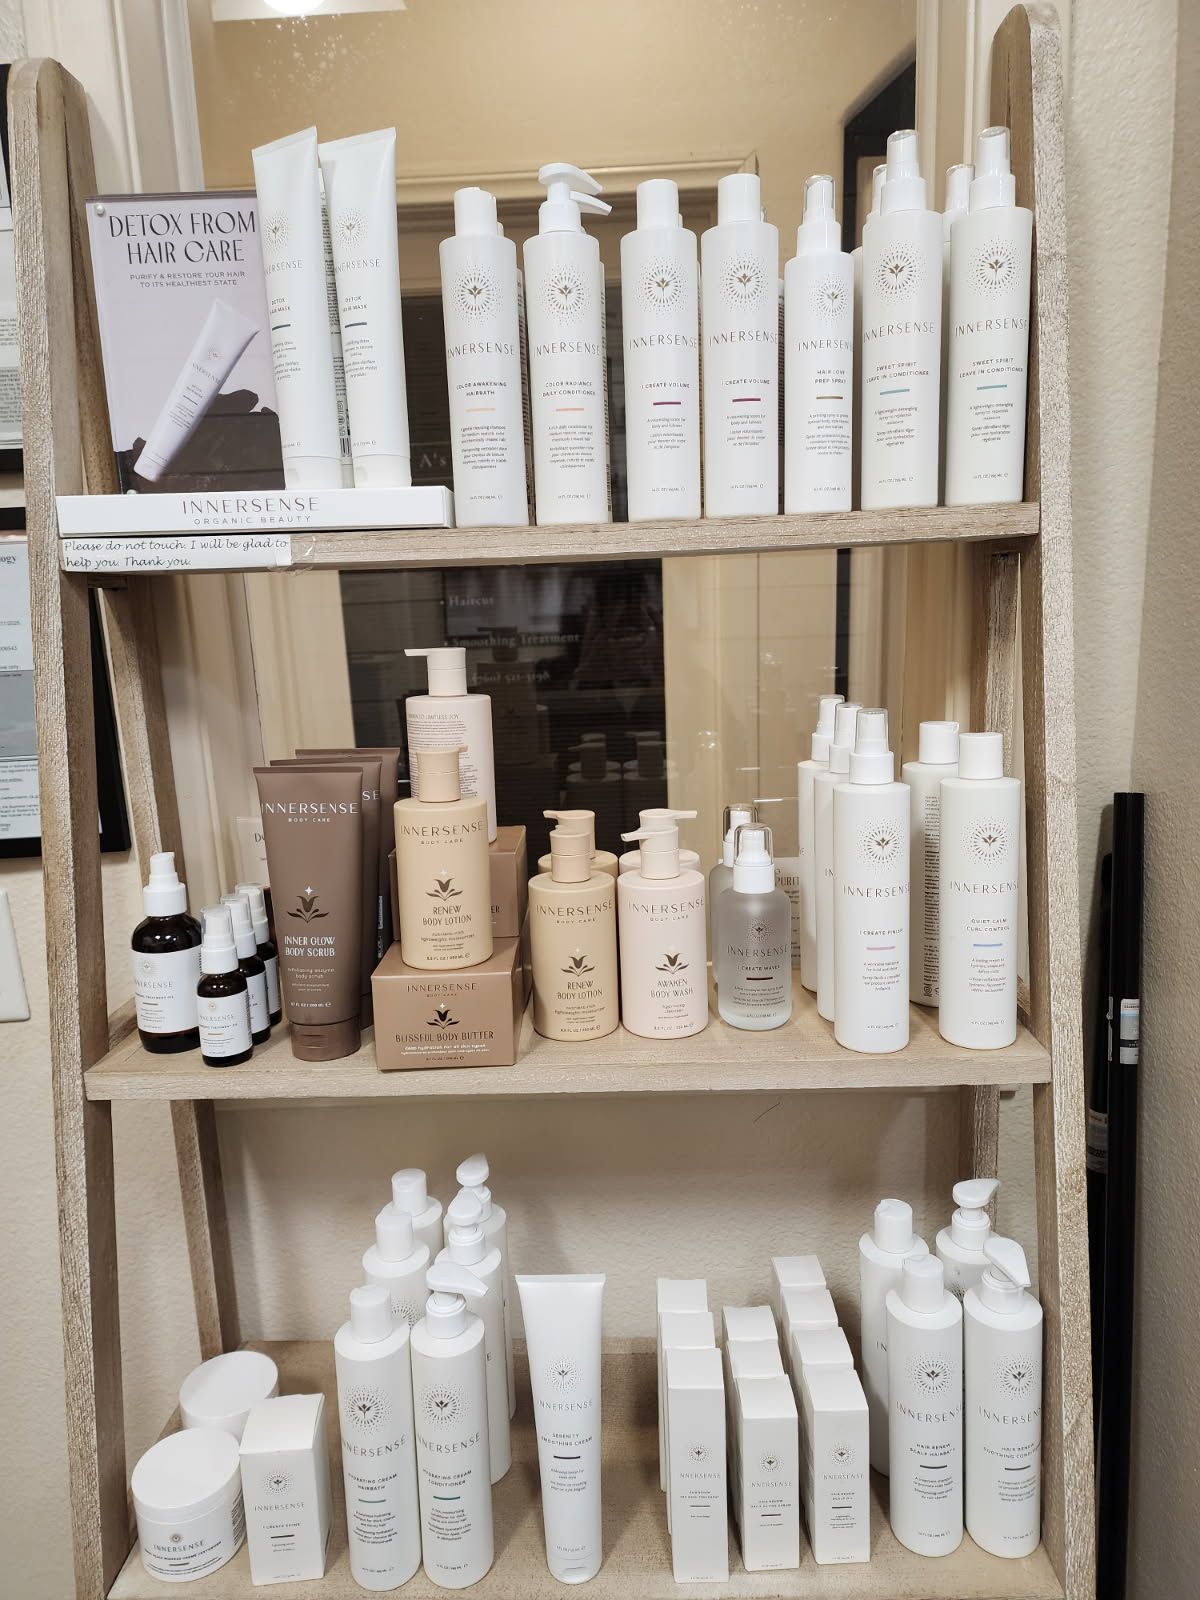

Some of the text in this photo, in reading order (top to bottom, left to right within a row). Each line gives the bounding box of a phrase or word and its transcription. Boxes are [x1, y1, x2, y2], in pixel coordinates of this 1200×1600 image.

[110, 211, 255, 237] DETOX FROM
[128, 240, 244, 264] HAIR CARE
[266, 260, 302, 274] NERSENSE
[335, 259, 380, 273] NNERSENSE
[798, 339, 853, 352] INNERSEN
[182, 497, 320, 515] INNERSENSE
[194, 515, 311, 525] ORGANIC BEAUTY
[64, 541, 103, 551] Please
[106, 540, 121, 551] do
[129, 540, 146, 550] not
[191, 540, 195, 550] I
[200, 538, 223, 549] will
[226, 539, 239, 548] be
[243, 538, 272, 551] glad
[276, 540, 287, 548] to
[0, 556, 16, 564] ogy
[66, 557, 91, 569] help
[124, 556, 165, 567] Thank
[450, 596, 494, 607] Haircut
[521, 634, 581, 645] Treatment
[261, 802, 359, 814] INNERSENSE
[400, 820, 483, 837] INNERSENSE
[775, 876, 800, 886] PURIT
[433, 905, 462, 915] RENEW
[536, 900, 613, 916] INNERSENSE
[629, 897, 704, 914] INNERSENSE
[423, 914, 472, 926] BODY LOTION
[284, 936, 336, 945] INNER GLOW
[285, 947, 335, 957] BODY SCRUB
[727, 944, 788, 957] INNERSENSE
[135, 980, 172, 988] NERSENSE
[407, 983, 478, 992] INNERSENSE
[567, 980, 594, 990] RENEW
[657, 978, 688, 988] AWAKEN
[557, 989, 603, 1000] BODY LOTION
[650, 988, 693, 998] BODY WASH
[395, 1031, 494, 1043] BLISSFUL BODY BUTTER
[979, 1406, 1042, 1425] INNERSEN
[343, 1434, 407, 1458] NNERSENSE
[418, 1432, 481, 1454] NNERSENSE
[378, 1473, 397, 1484] CREAM
[453, 1470, 472, 1479] CREAM
[254, 1502, 305, 1512] INNERSENSE
[153, 1540, 204, 1553] INNERSENSE
